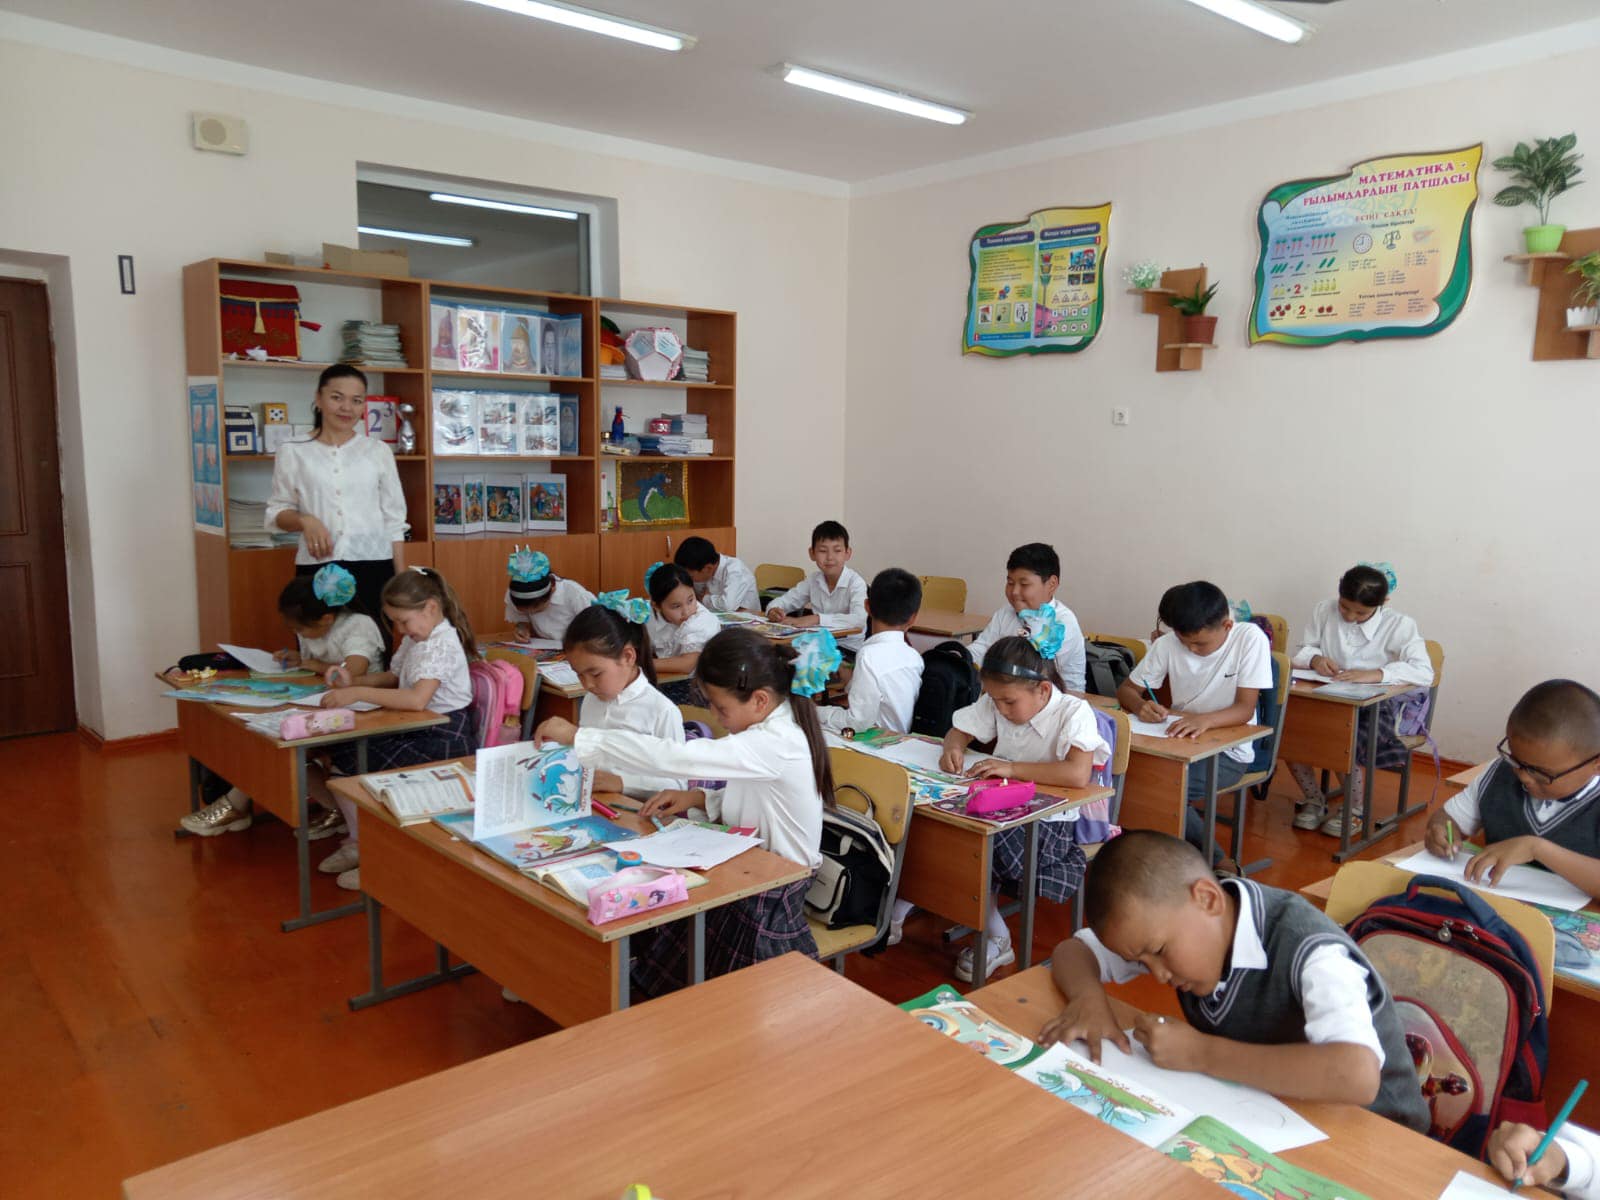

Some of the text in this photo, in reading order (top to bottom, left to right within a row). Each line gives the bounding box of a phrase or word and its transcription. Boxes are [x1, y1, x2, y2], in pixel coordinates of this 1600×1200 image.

[1359, 162, 1455, 185] МАТЕМАТИКА
[1403, 172, 1470, 192] ПАТШАСЫ
[1294, 284, 1301, 294] 2
[1298, 305, 1306, 315] 2
[368, 408, 382, 432] 2
